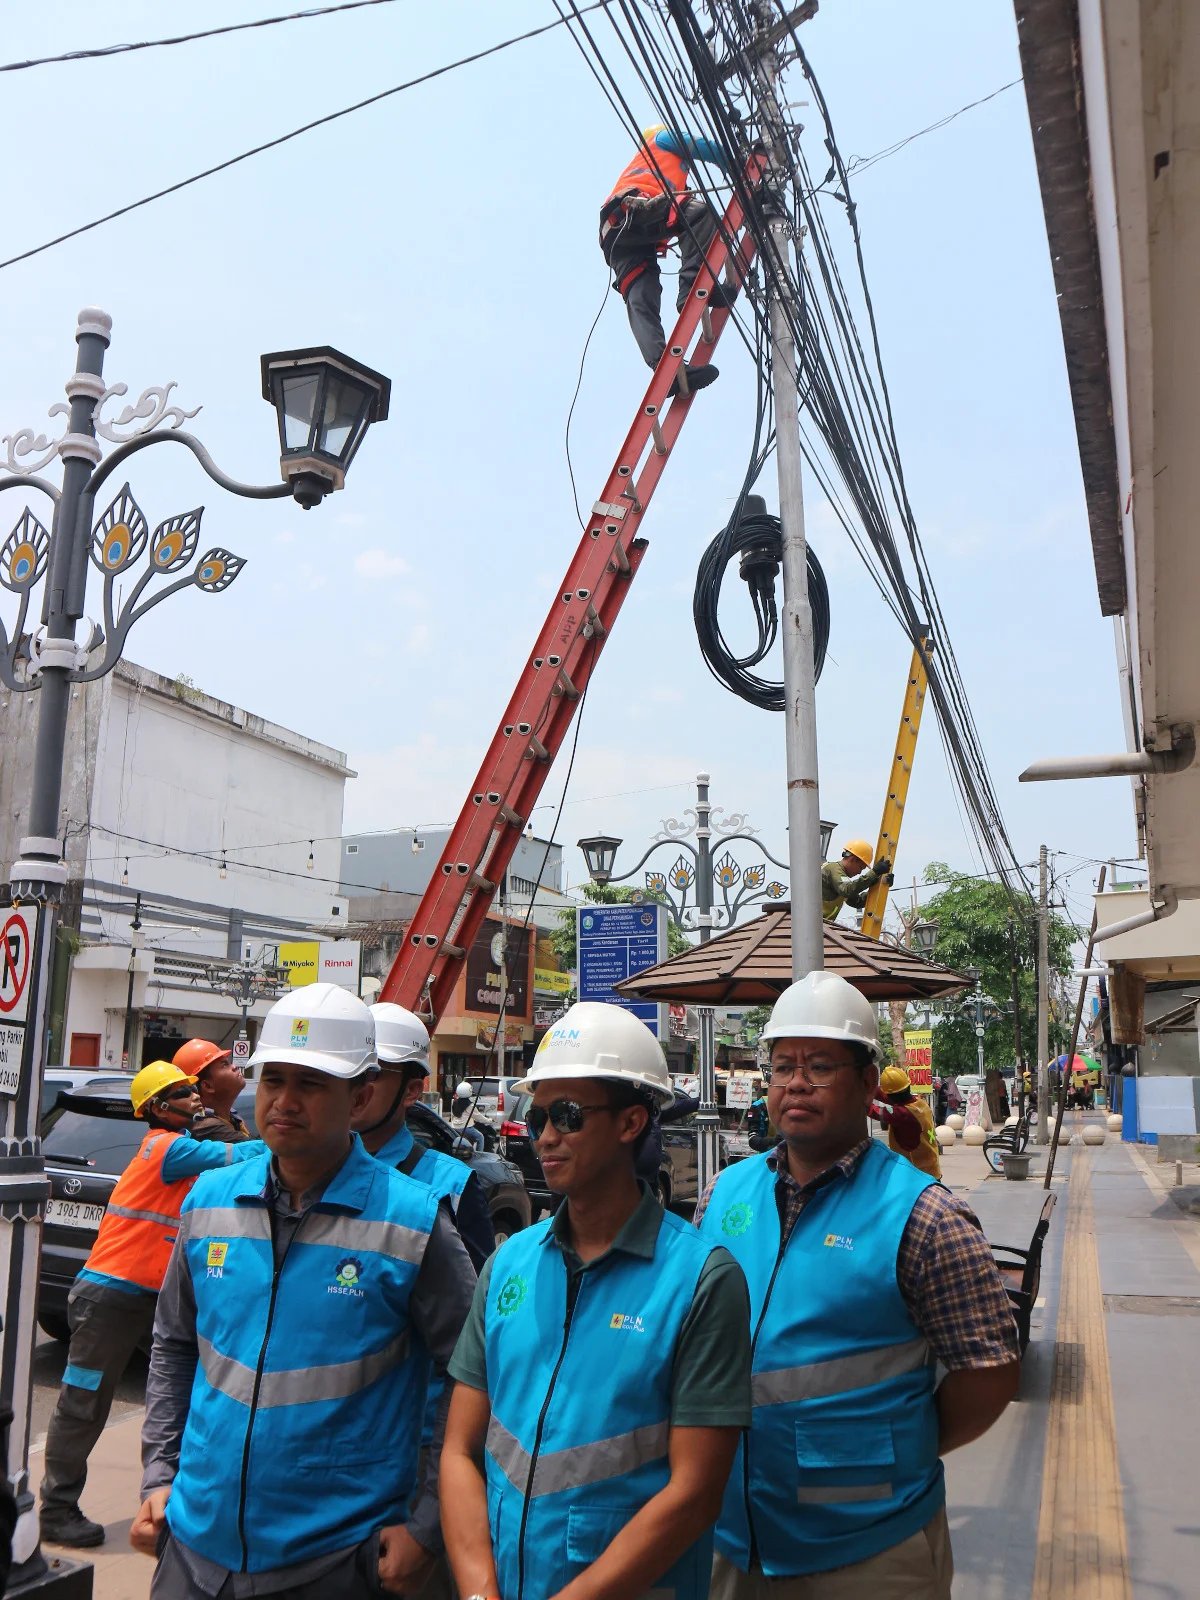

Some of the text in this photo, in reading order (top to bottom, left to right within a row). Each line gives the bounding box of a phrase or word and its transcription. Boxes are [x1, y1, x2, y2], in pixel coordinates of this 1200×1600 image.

[289, 960, 315, 968] Miyako
[324, 959, 353, 968] Rinnai
[7, 1030, 23, 1045] Parkir
[552, 1029, 580, 1040] PLN
[46, 1201, 103, 1222] B 1961 DKR
[206, 1267, 223, 1279] PLN
[623, 1315, 643, 1326] PLN
